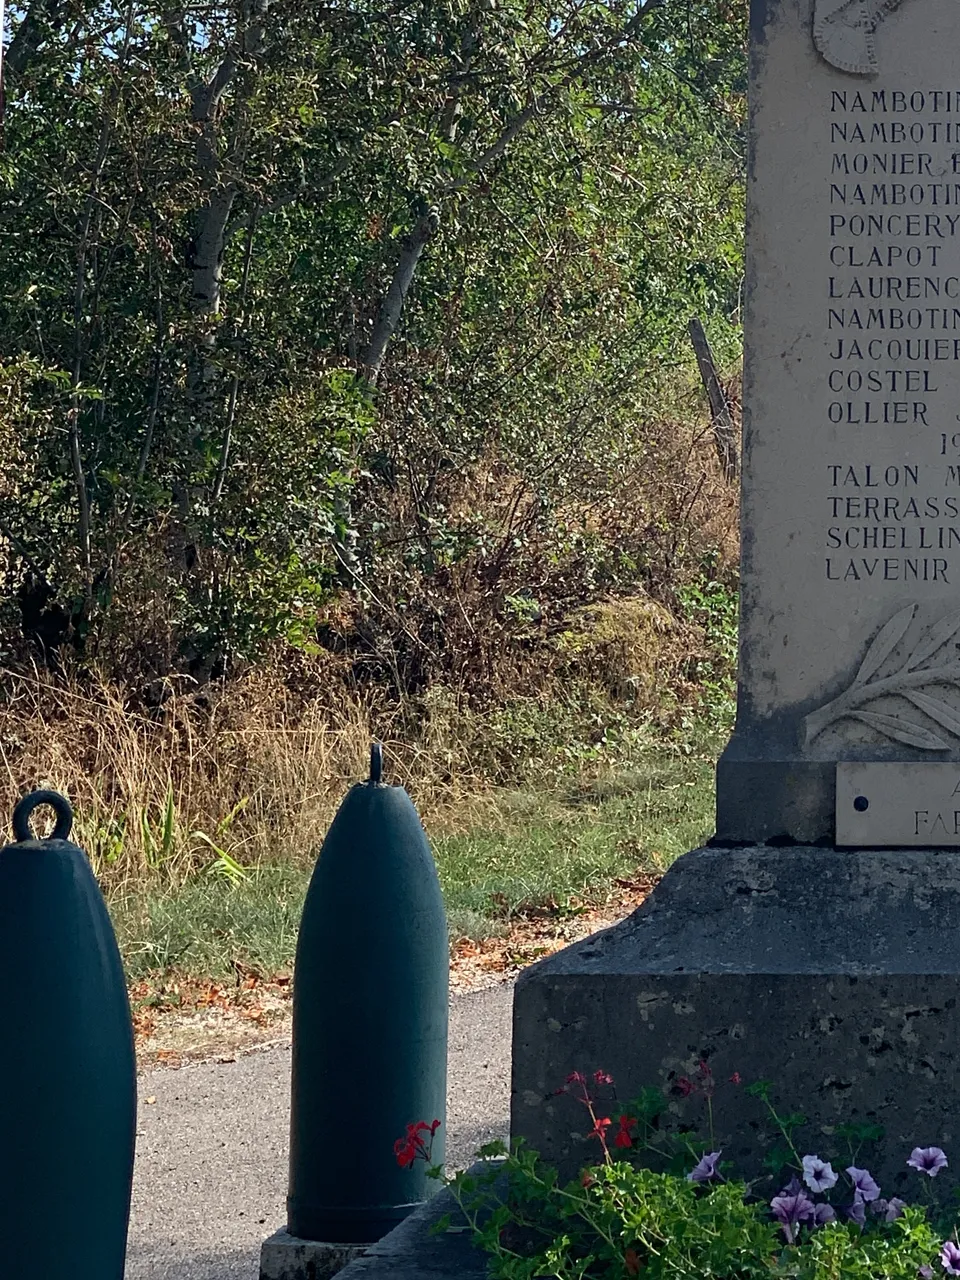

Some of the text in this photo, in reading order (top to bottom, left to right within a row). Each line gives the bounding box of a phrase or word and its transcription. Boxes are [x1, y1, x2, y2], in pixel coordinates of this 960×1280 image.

[830, 152, 934, 177] MONIER
[828, 466, 918, 487] TALON
[825, 558, 950, 584] LAVENIR
